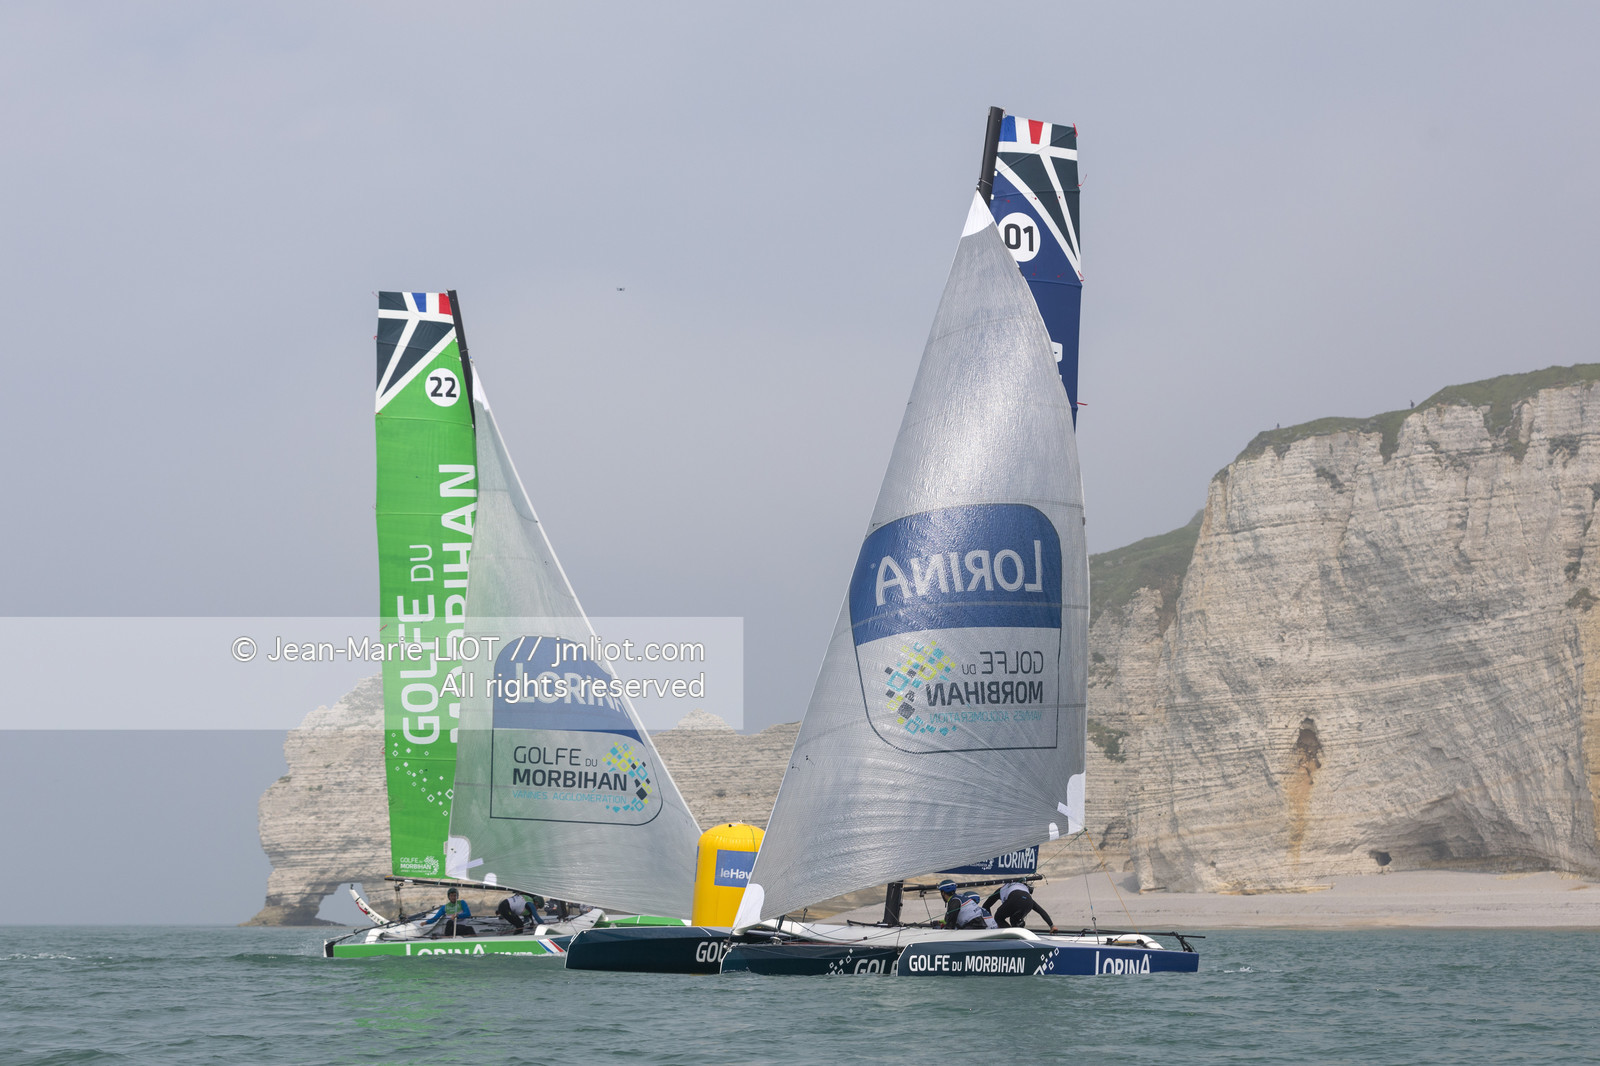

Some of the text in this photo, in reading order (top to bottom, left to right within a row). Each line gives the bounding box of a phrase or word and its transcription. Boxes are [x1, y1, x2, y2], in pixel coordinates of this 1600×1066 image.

[1004, 223, 1034, 252] 01
[429, 376, 458, 399] 22
[396, 544, 441, 745] GOLFE DU
[513, 746, 598, 767] GOLFE DU
[512, 768, 627, 792] MORBIHAN
[512, 790, 548, 801] VANNES
[998, 847, 1036, 870] LORINA
[908, 954, 1026, 974] GOLFE DU MORBIHAN
